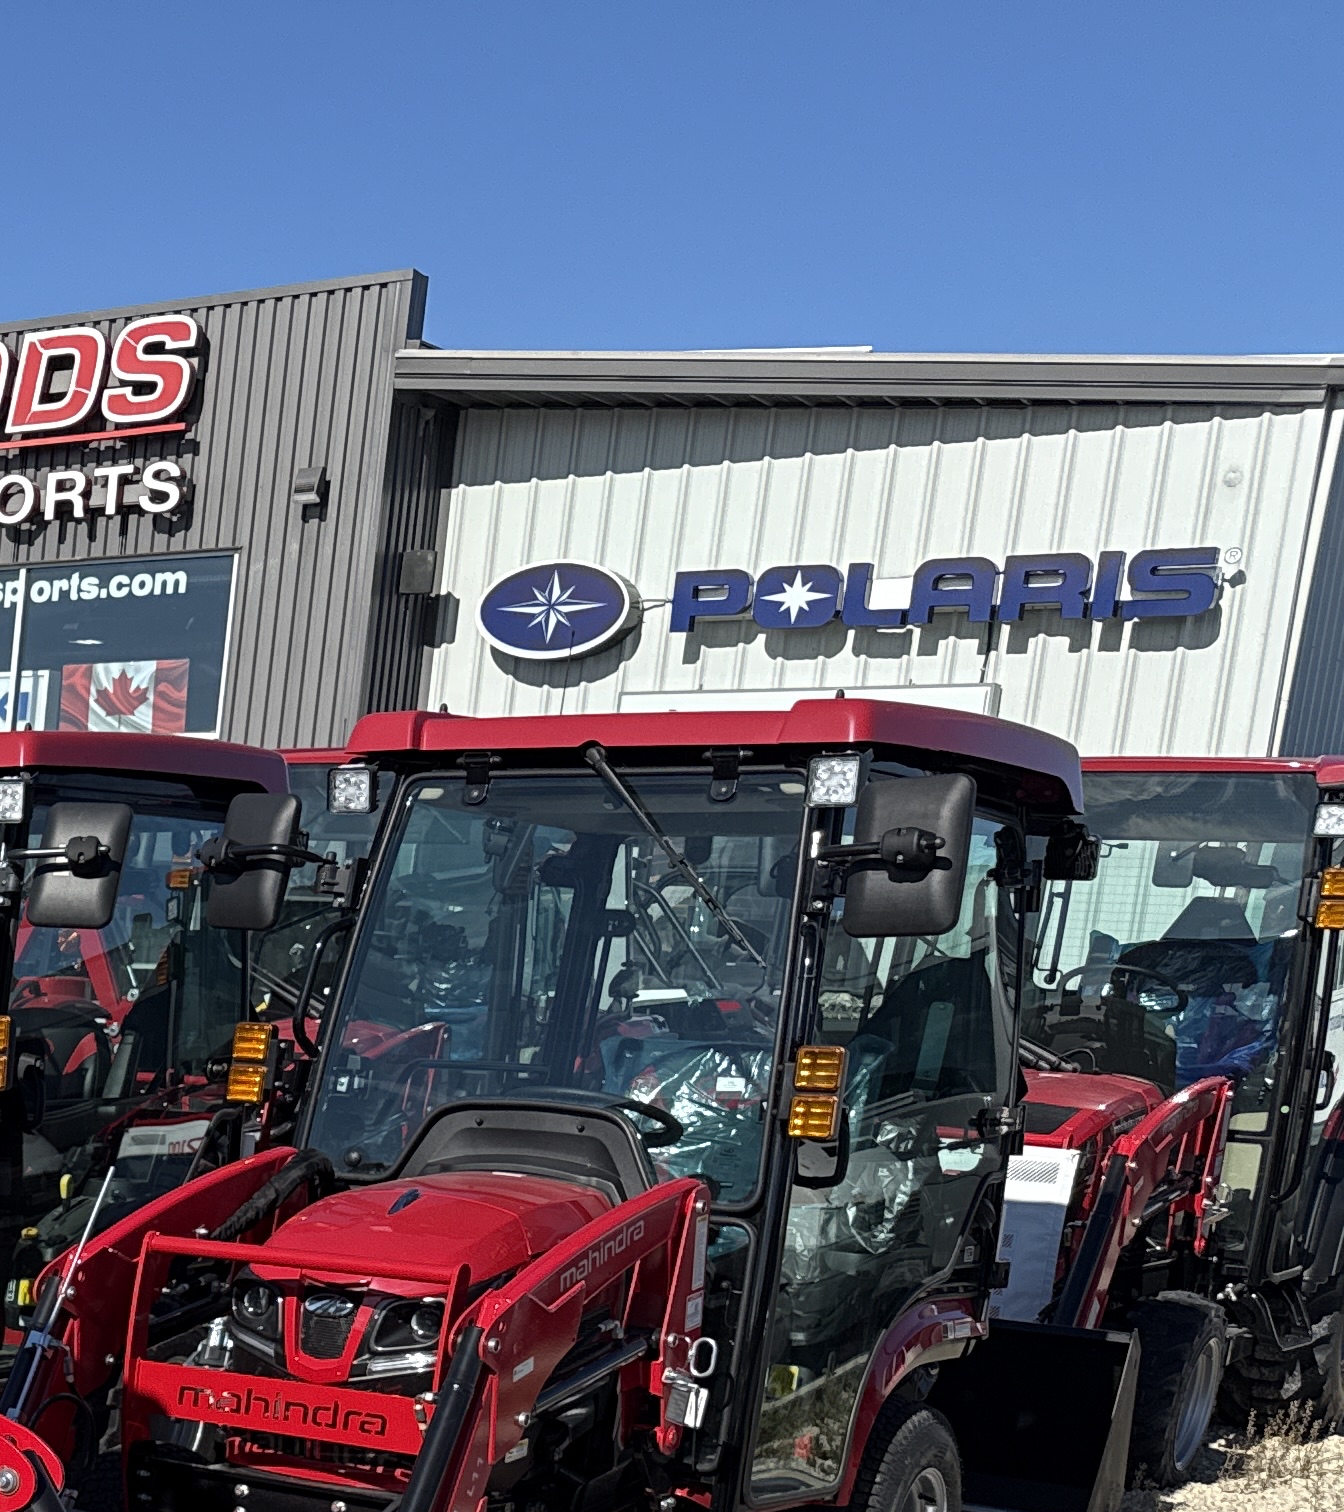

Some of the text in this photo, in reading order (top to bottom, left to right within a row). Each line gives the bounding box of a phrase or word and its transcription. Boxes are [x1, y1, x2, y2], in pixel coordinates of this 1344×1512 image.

[670, 547, 1220, 632] POLARIS
[559, 1219, 645, 1292] mahindra
[177, 1385, 389, 1438] mahindra
